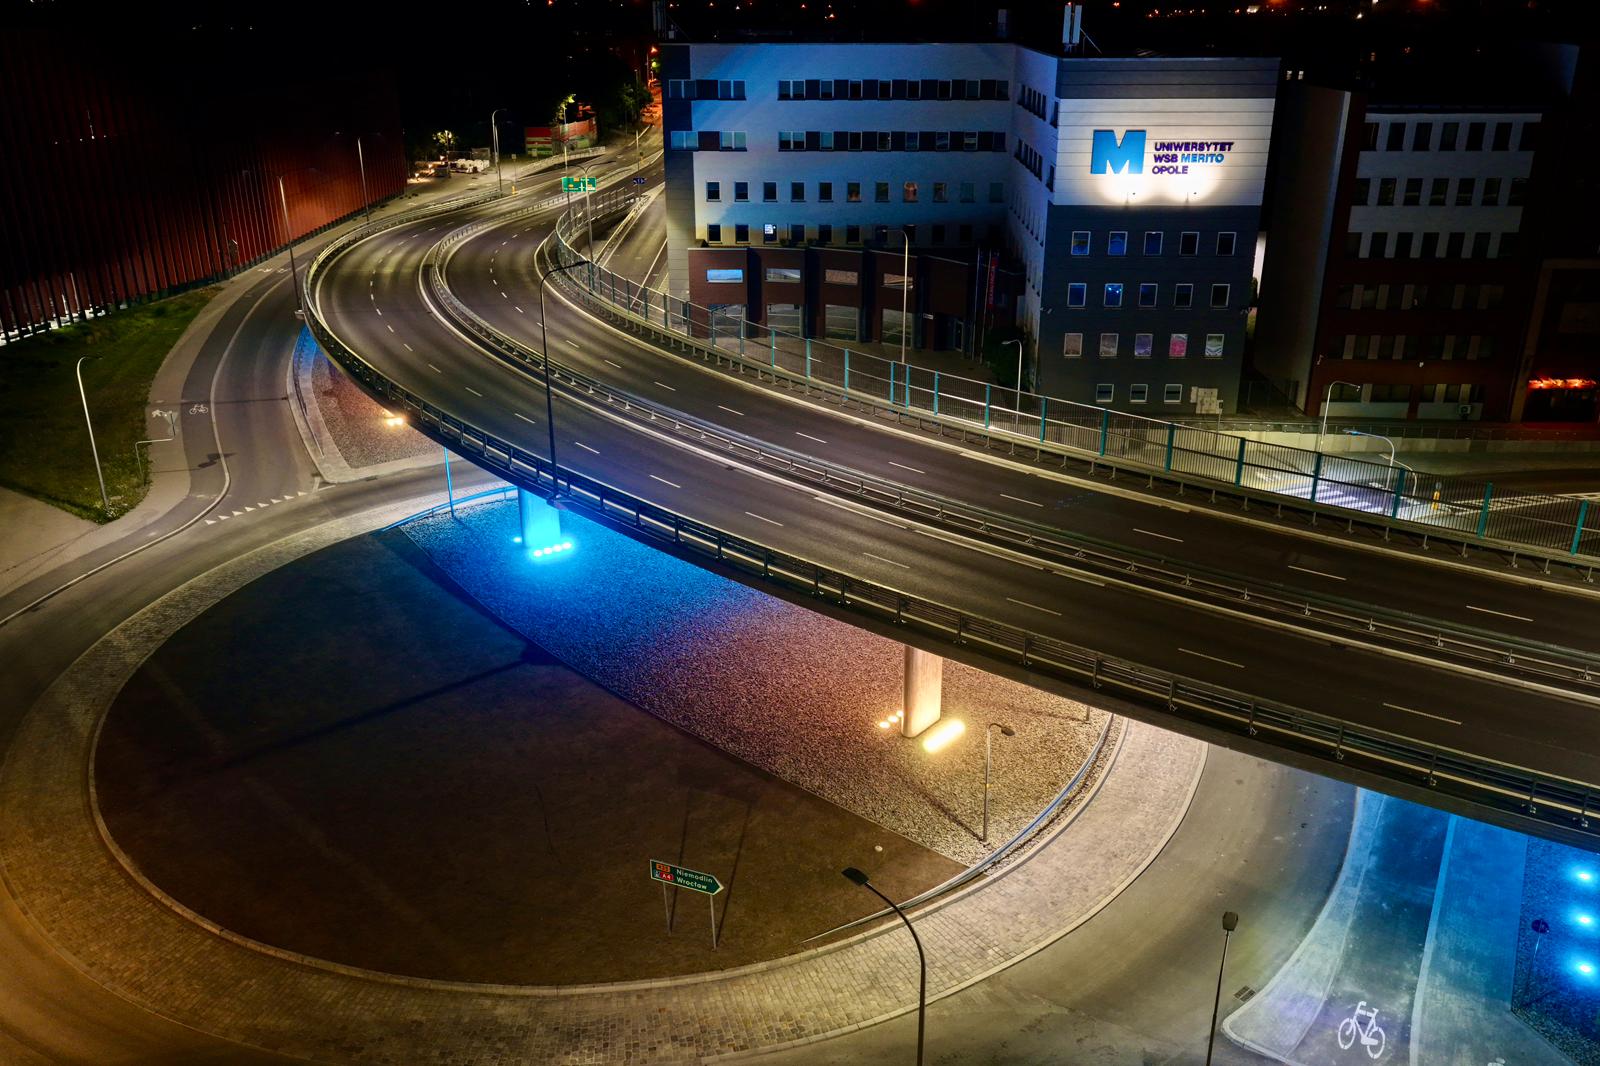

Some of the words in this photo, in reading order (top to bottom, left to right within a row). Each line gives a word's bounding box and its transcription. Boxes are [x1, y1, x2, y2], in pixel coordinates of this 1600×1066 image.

[1091, 129, 1147, 174] M
[1154, 142, 1234, 151] UNIWERSYTET
[1153, 154, 1178, 163] WSB
[1181, 153, 1225, 163] MERITO
[1152, 165, 1189, 175] OPOLE
[676, 869, 713, 883] Niemodlin
